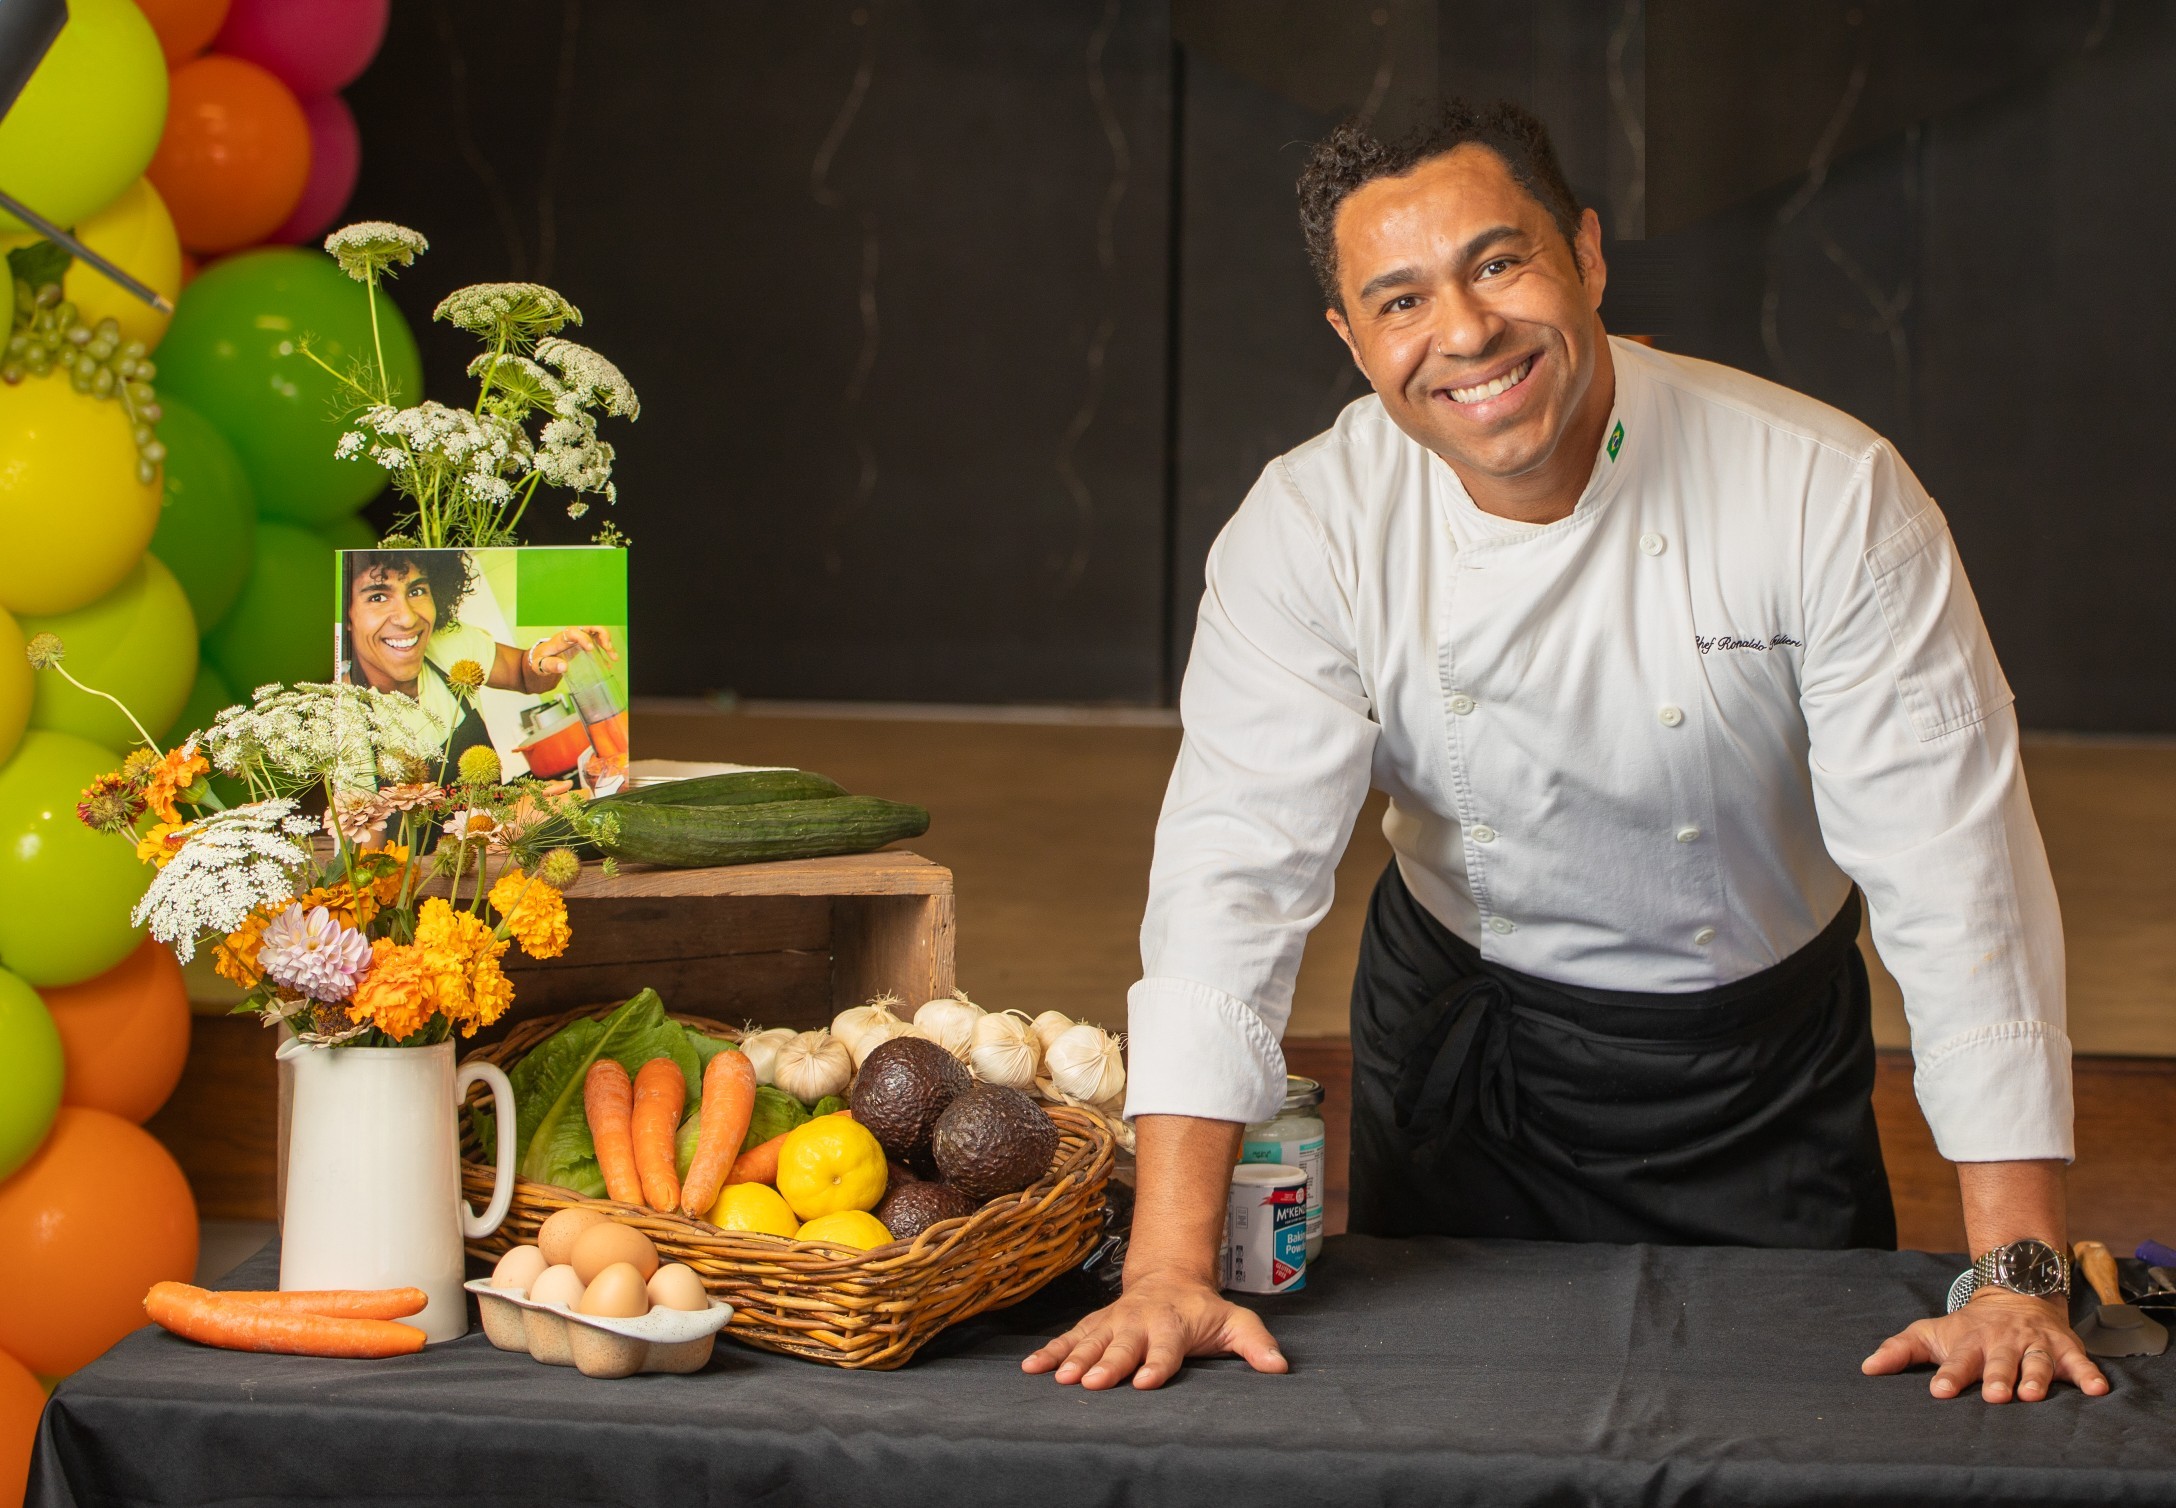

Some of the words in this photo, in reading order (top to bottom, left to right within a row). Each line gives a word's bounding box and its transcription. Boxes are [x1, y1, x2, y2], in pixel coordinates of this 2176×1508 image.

[1717, 636, 1767, 652] Ronaldo
[1276, 1203, 1306, 1223] McKENZ
[1287, 1230, 1306, 1244] Bakin
[1285, 1241, 1306, 1255] Powd
